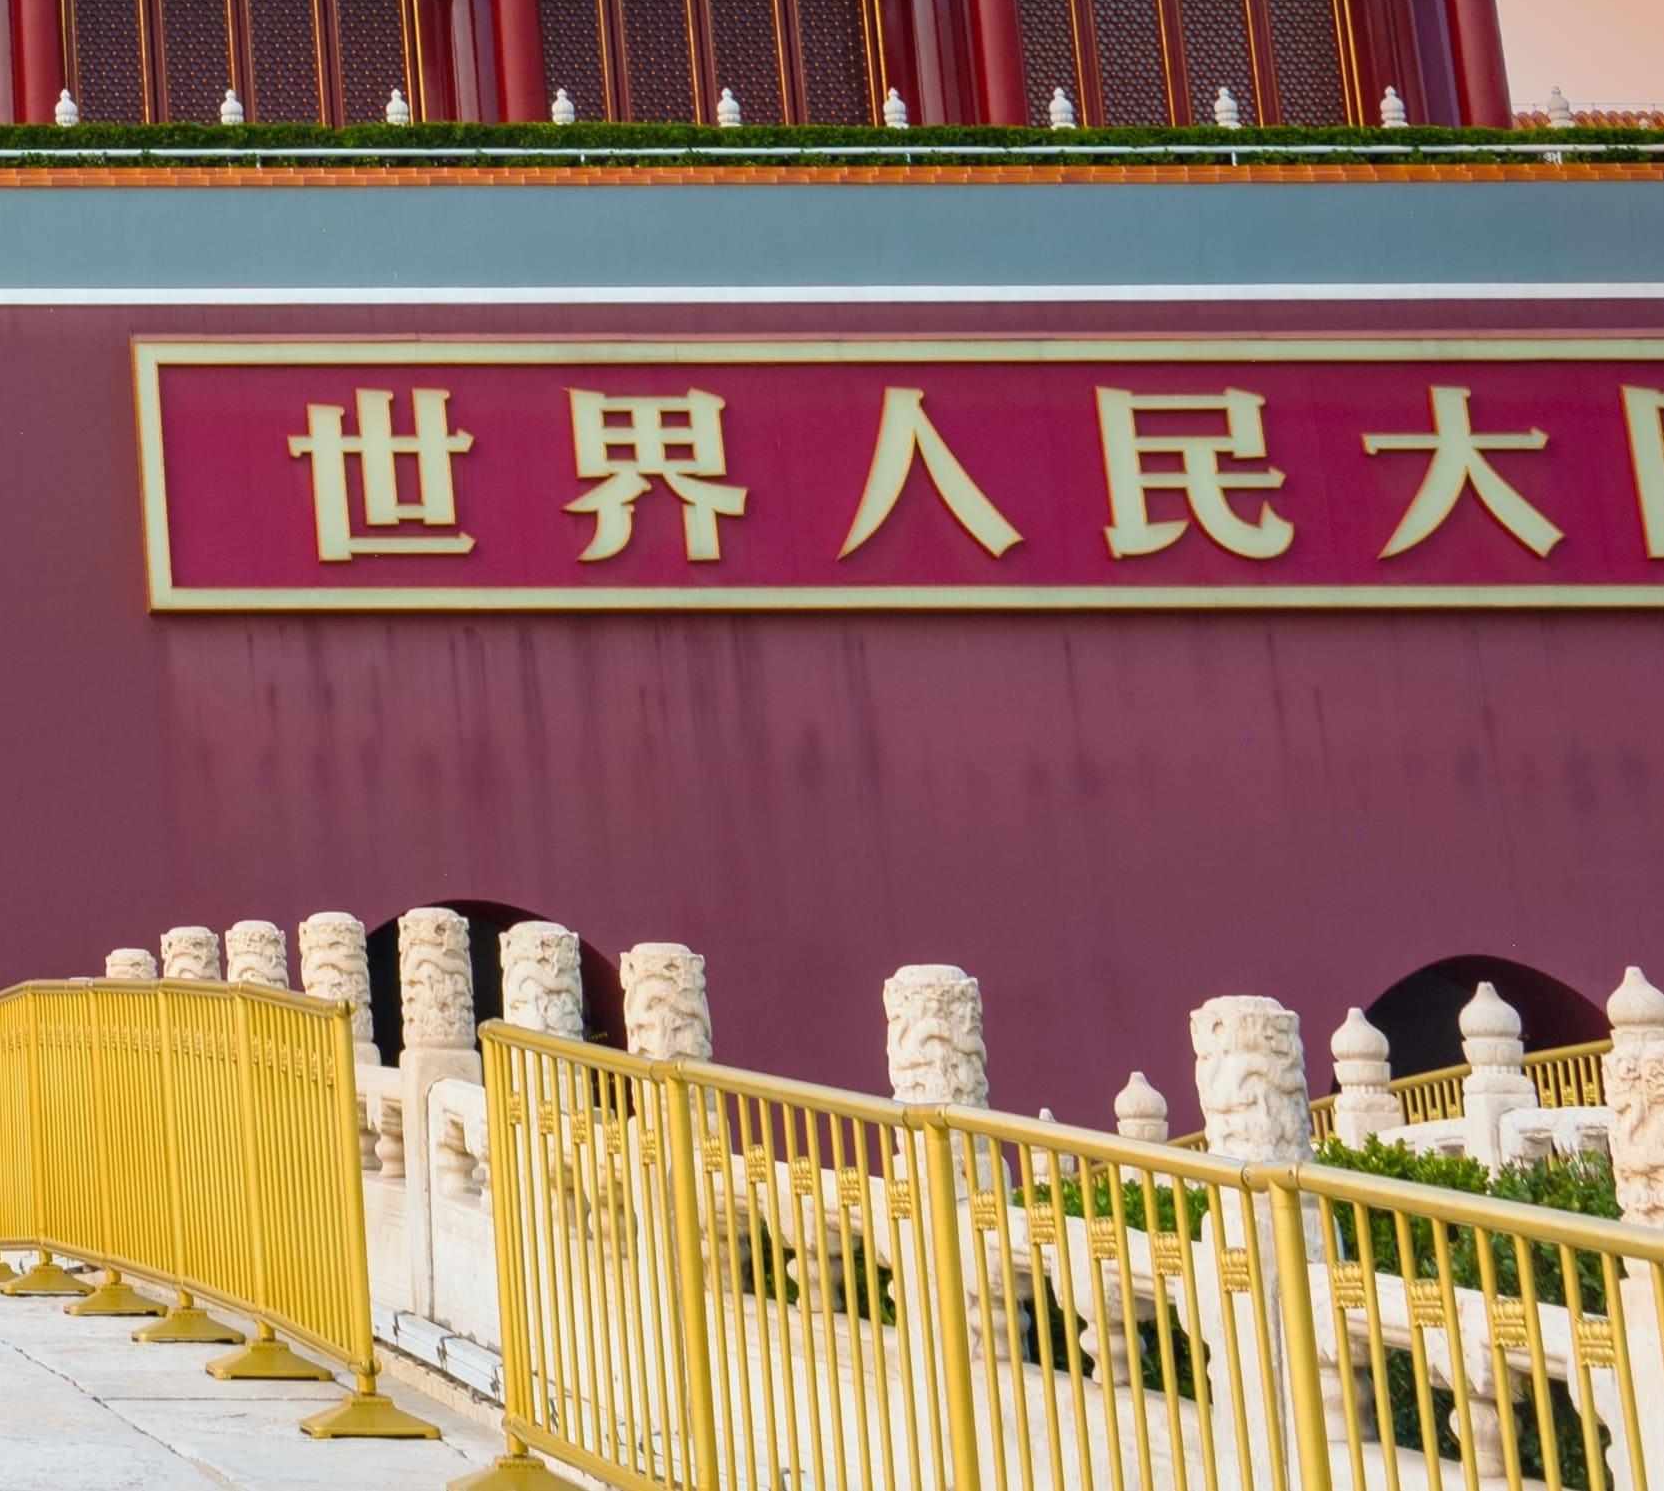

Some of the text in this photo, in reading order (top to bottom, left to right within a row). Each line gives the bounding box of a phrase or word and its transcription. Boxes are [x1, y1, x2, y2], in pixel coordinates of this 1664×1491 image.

[287, 386, 1664, 561] 世界人民大
